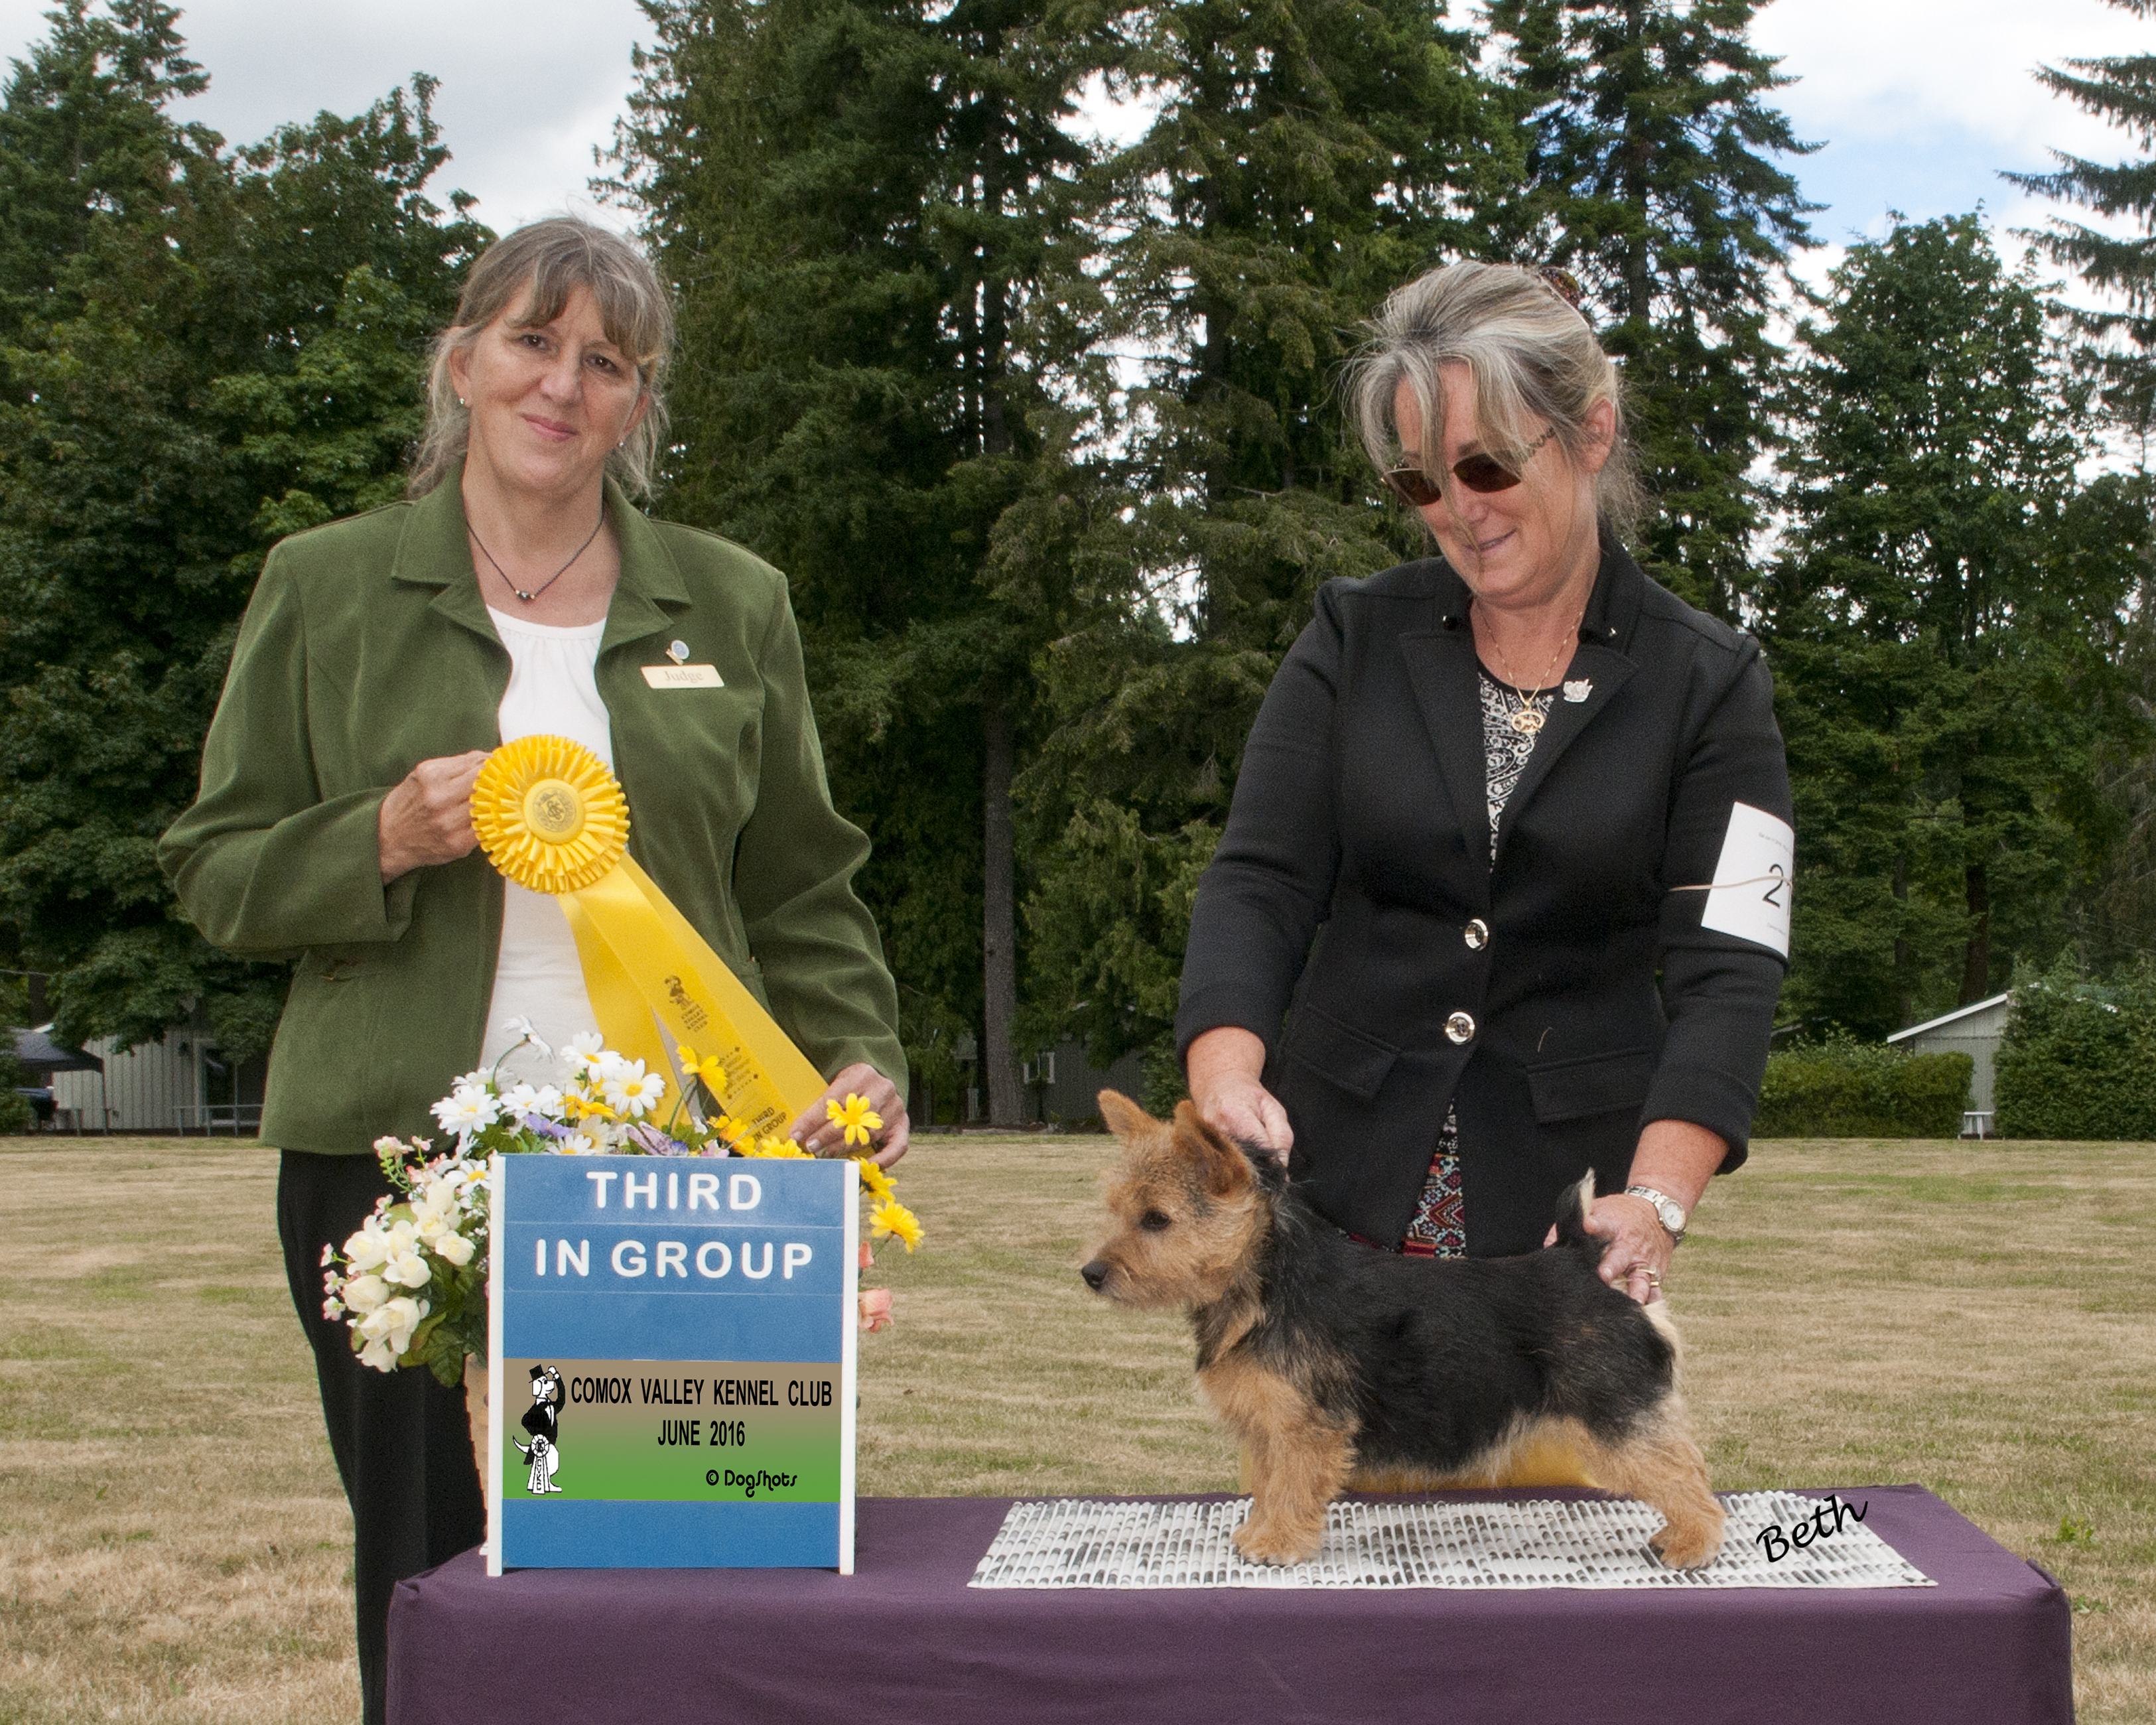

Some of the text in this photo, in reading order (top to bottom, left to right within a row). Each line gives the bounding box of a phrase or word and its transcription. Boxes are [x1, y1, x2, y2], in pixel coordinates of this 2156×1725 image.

[664, 670, 705, 683] Judge
[752, 1107, 775, 1126] THIRD
[762, 1112, 787, 1135] GROUP
[586, 1171, 762, 1210] THIRD
[535, 1238, 813, 1279] IN GROUP
